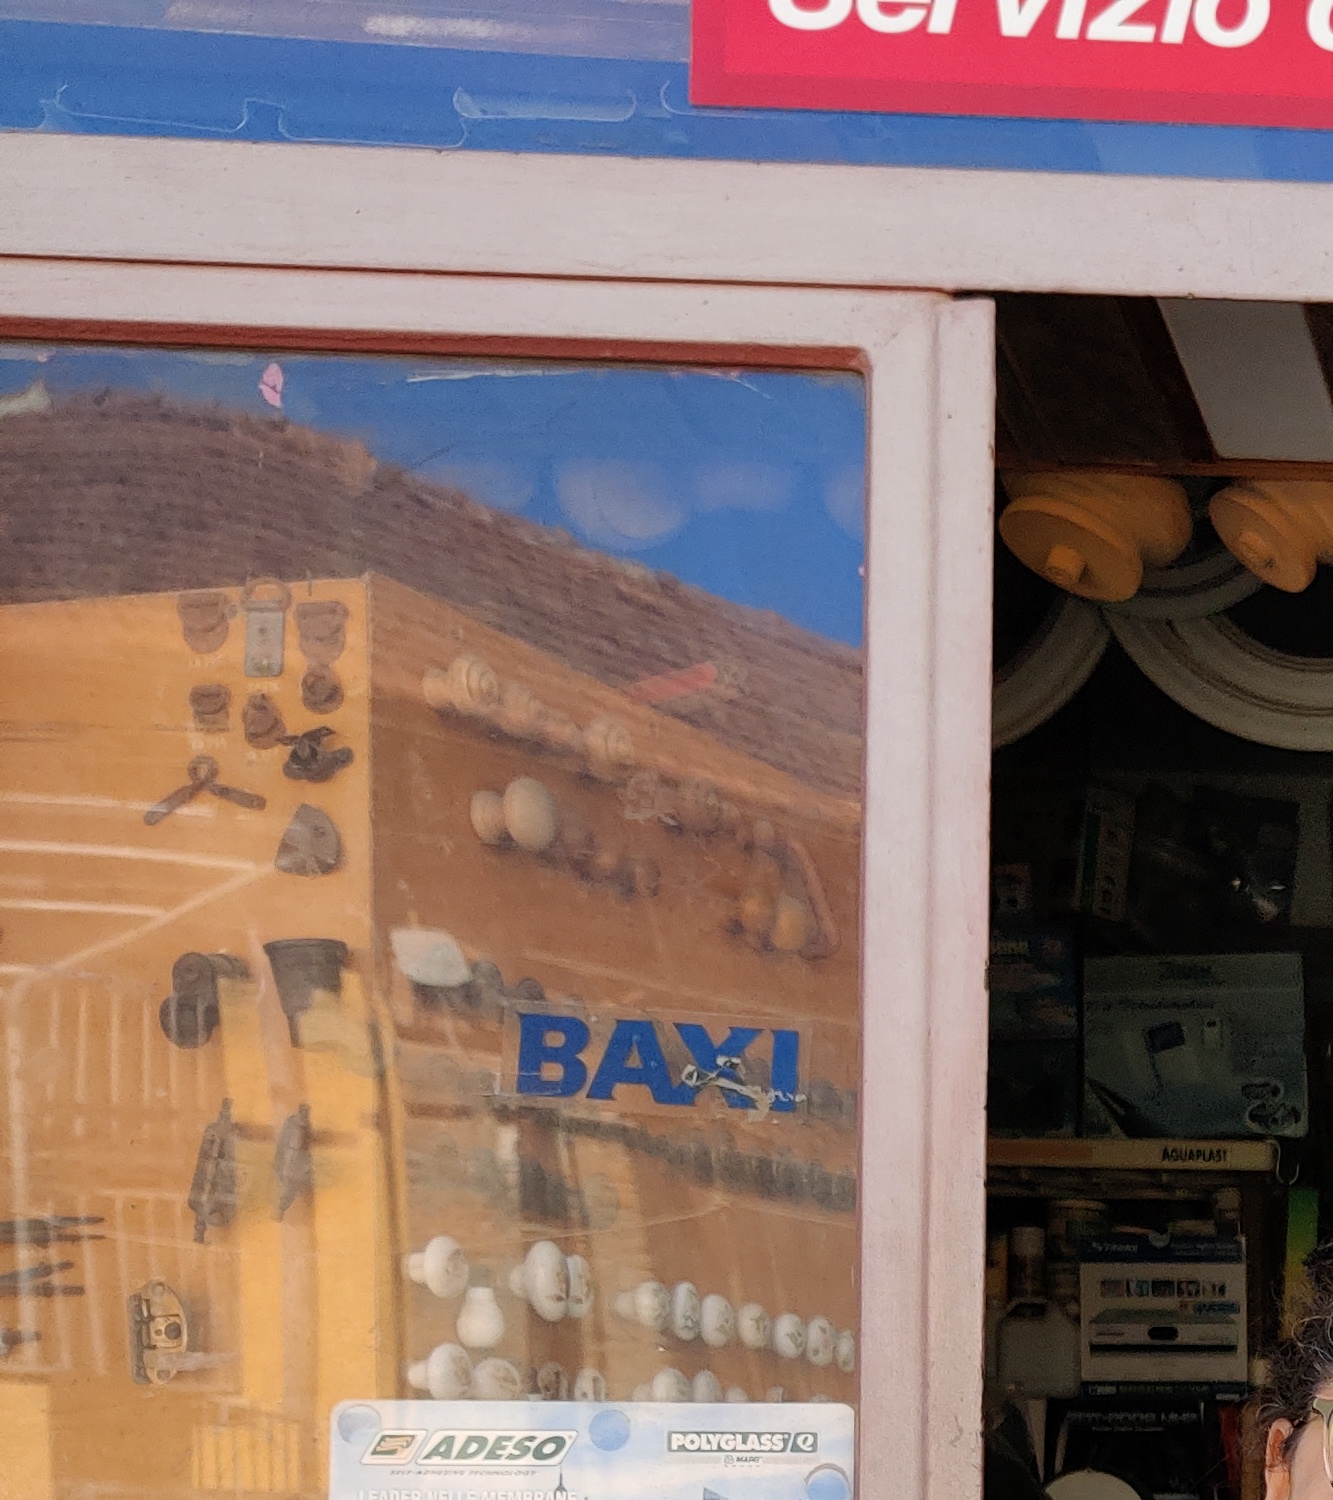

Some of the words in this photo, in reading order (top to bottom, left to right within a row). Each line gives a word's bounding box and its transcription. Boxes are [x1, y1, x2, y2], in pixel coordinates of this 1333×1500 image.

[516, 1012, 801, 1114] BAXI
[422, 1435, 568, 1461] ADESO
[671, 1432, 785, 1451] POLYGLASS
